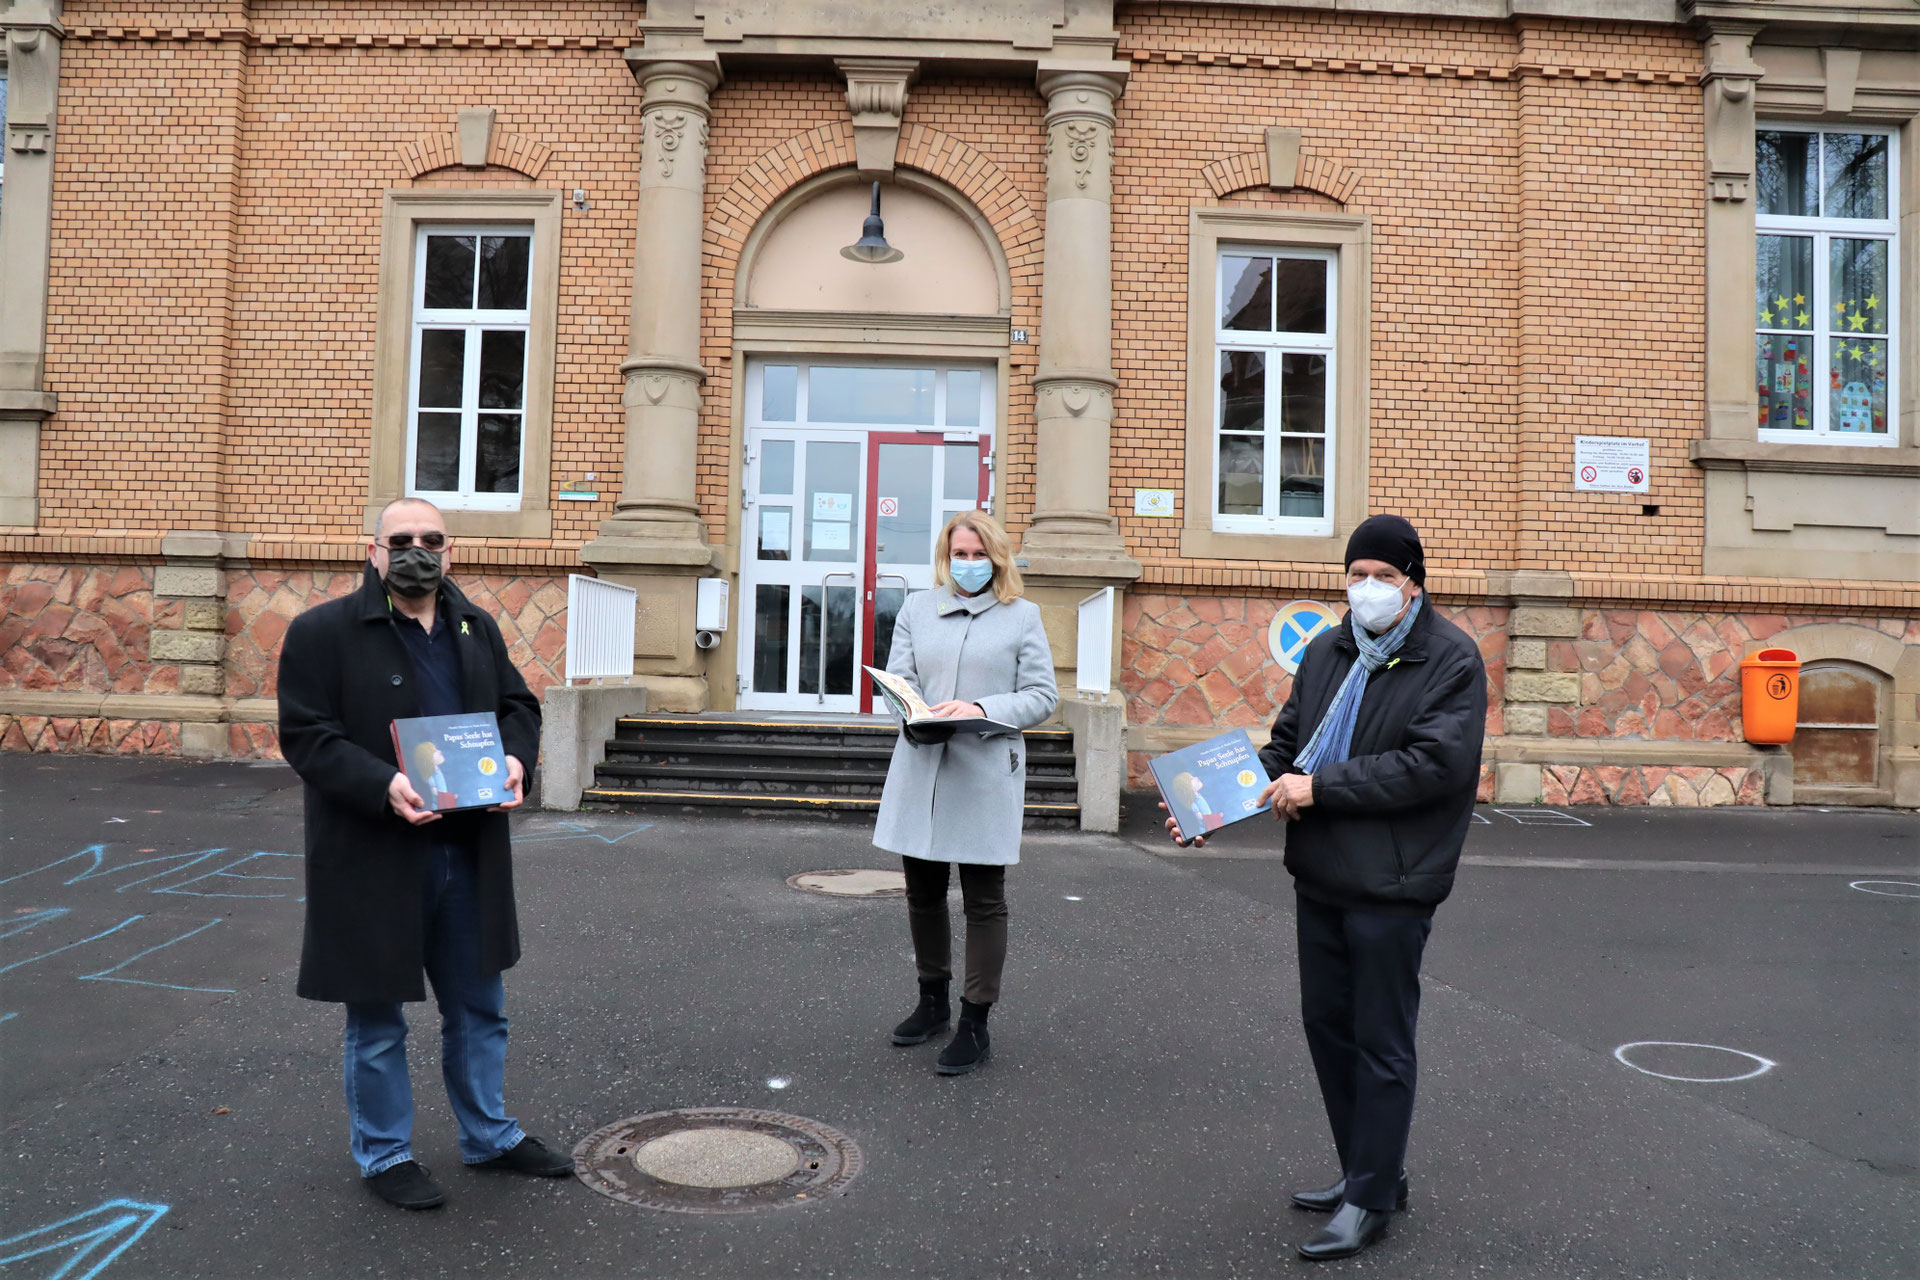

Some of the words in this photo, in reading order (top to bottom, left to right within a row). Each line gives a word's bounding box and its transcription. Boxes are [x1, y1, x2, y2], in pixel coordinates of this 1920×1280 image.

[1014, 330, 1024, 341] 14
[444, 734, 463, 742] Papas
[460, 739, 495, 749] Schnupfen
[1198, 757, 1216, 767] Papas
[1217, 750, 1234, 760] Seele
[1215, 754, 1250, 769] Schnupfen
